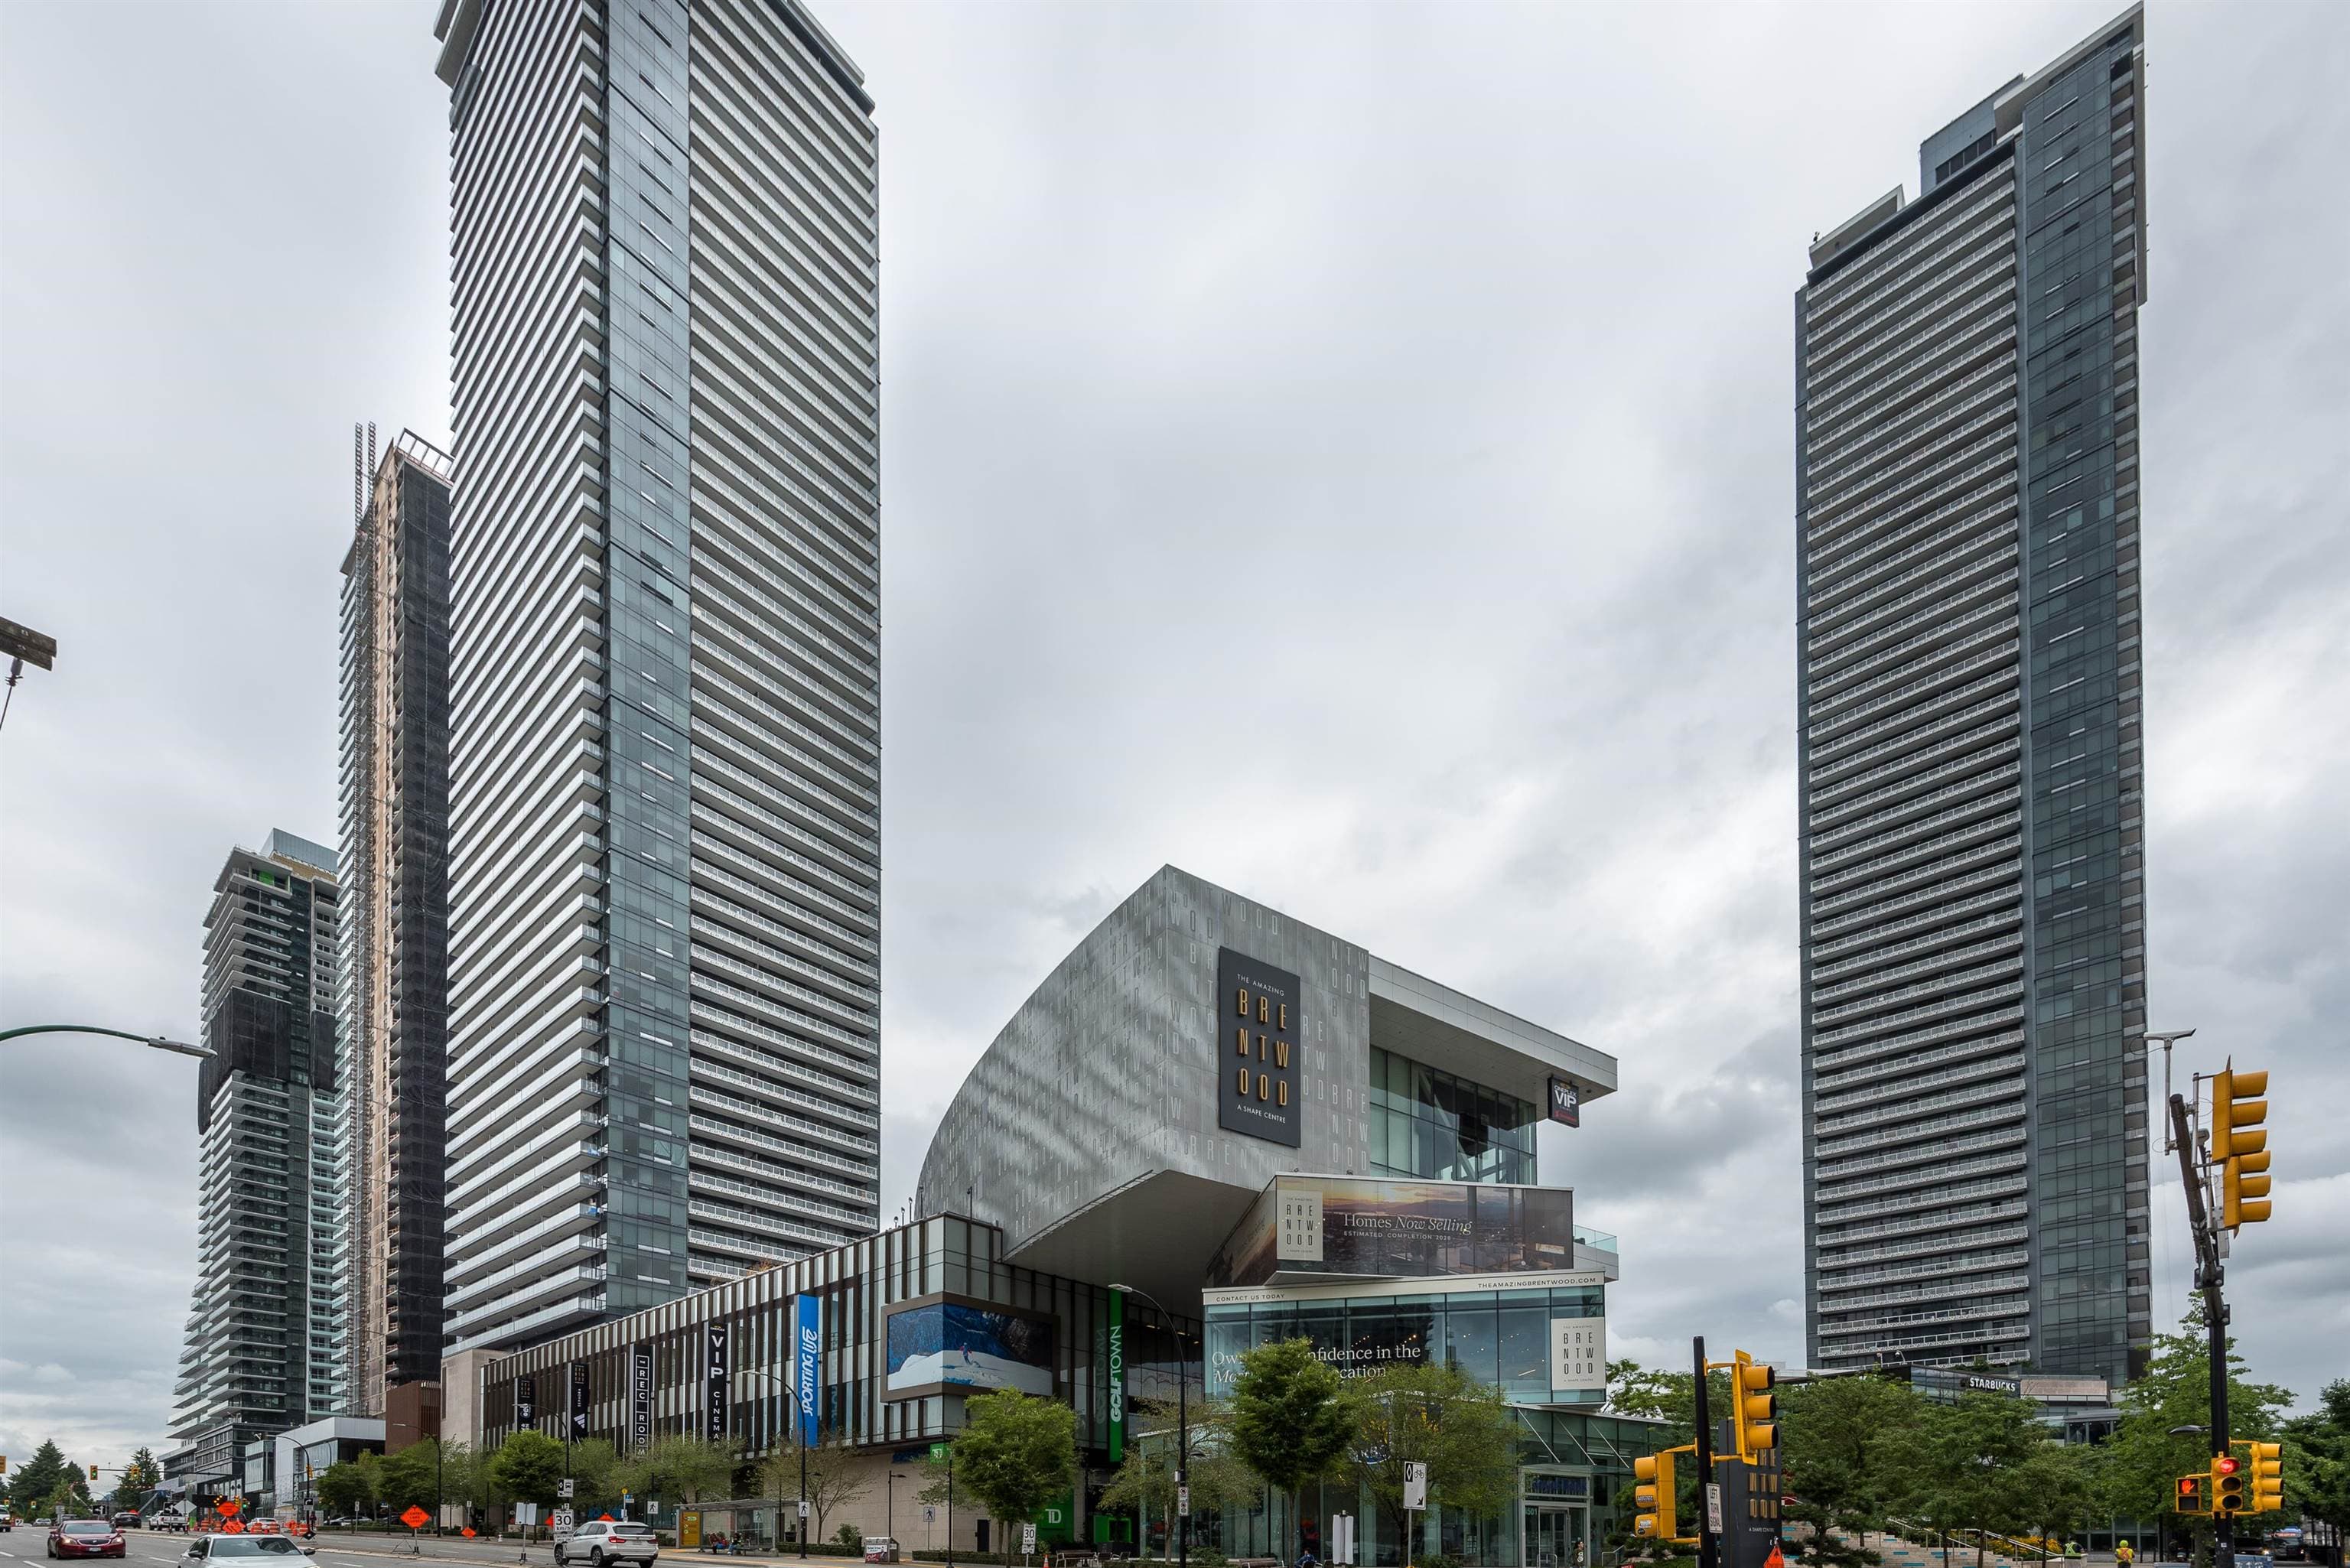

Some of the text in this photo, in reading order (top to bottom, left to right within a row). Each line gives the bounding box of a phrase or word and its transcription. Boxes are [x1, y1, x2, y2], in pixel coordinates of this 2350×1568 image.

[1237, 973, 1285, 997] THE AMAZING
[1554, 1089, 1577, 1108] VIP
[1243, 1105, 1263, 1117] SHAPE
[1264, 1111, 1287, 1124] CENTRE
[1344, 1213, 1473, 1236] Homes Now Selling
[1387, 1232, 1433, 1241] COMPLETION
[1478, 1277, 1597, 1289] THEAMAZINGBRENTWOOD.COM
[710, 1335, 724, 1379] VIP
[1376, 1345, 1391, 1359] in
[1395, 1344, 1421, 1359] the
[1970, 1378, 2016, 1392] STARBUCKS
[555, 1515, 571, 1526] 30
[1045, 1508, 1062, 1524] TD
[1024, 1529, 1035, 1538] 30
